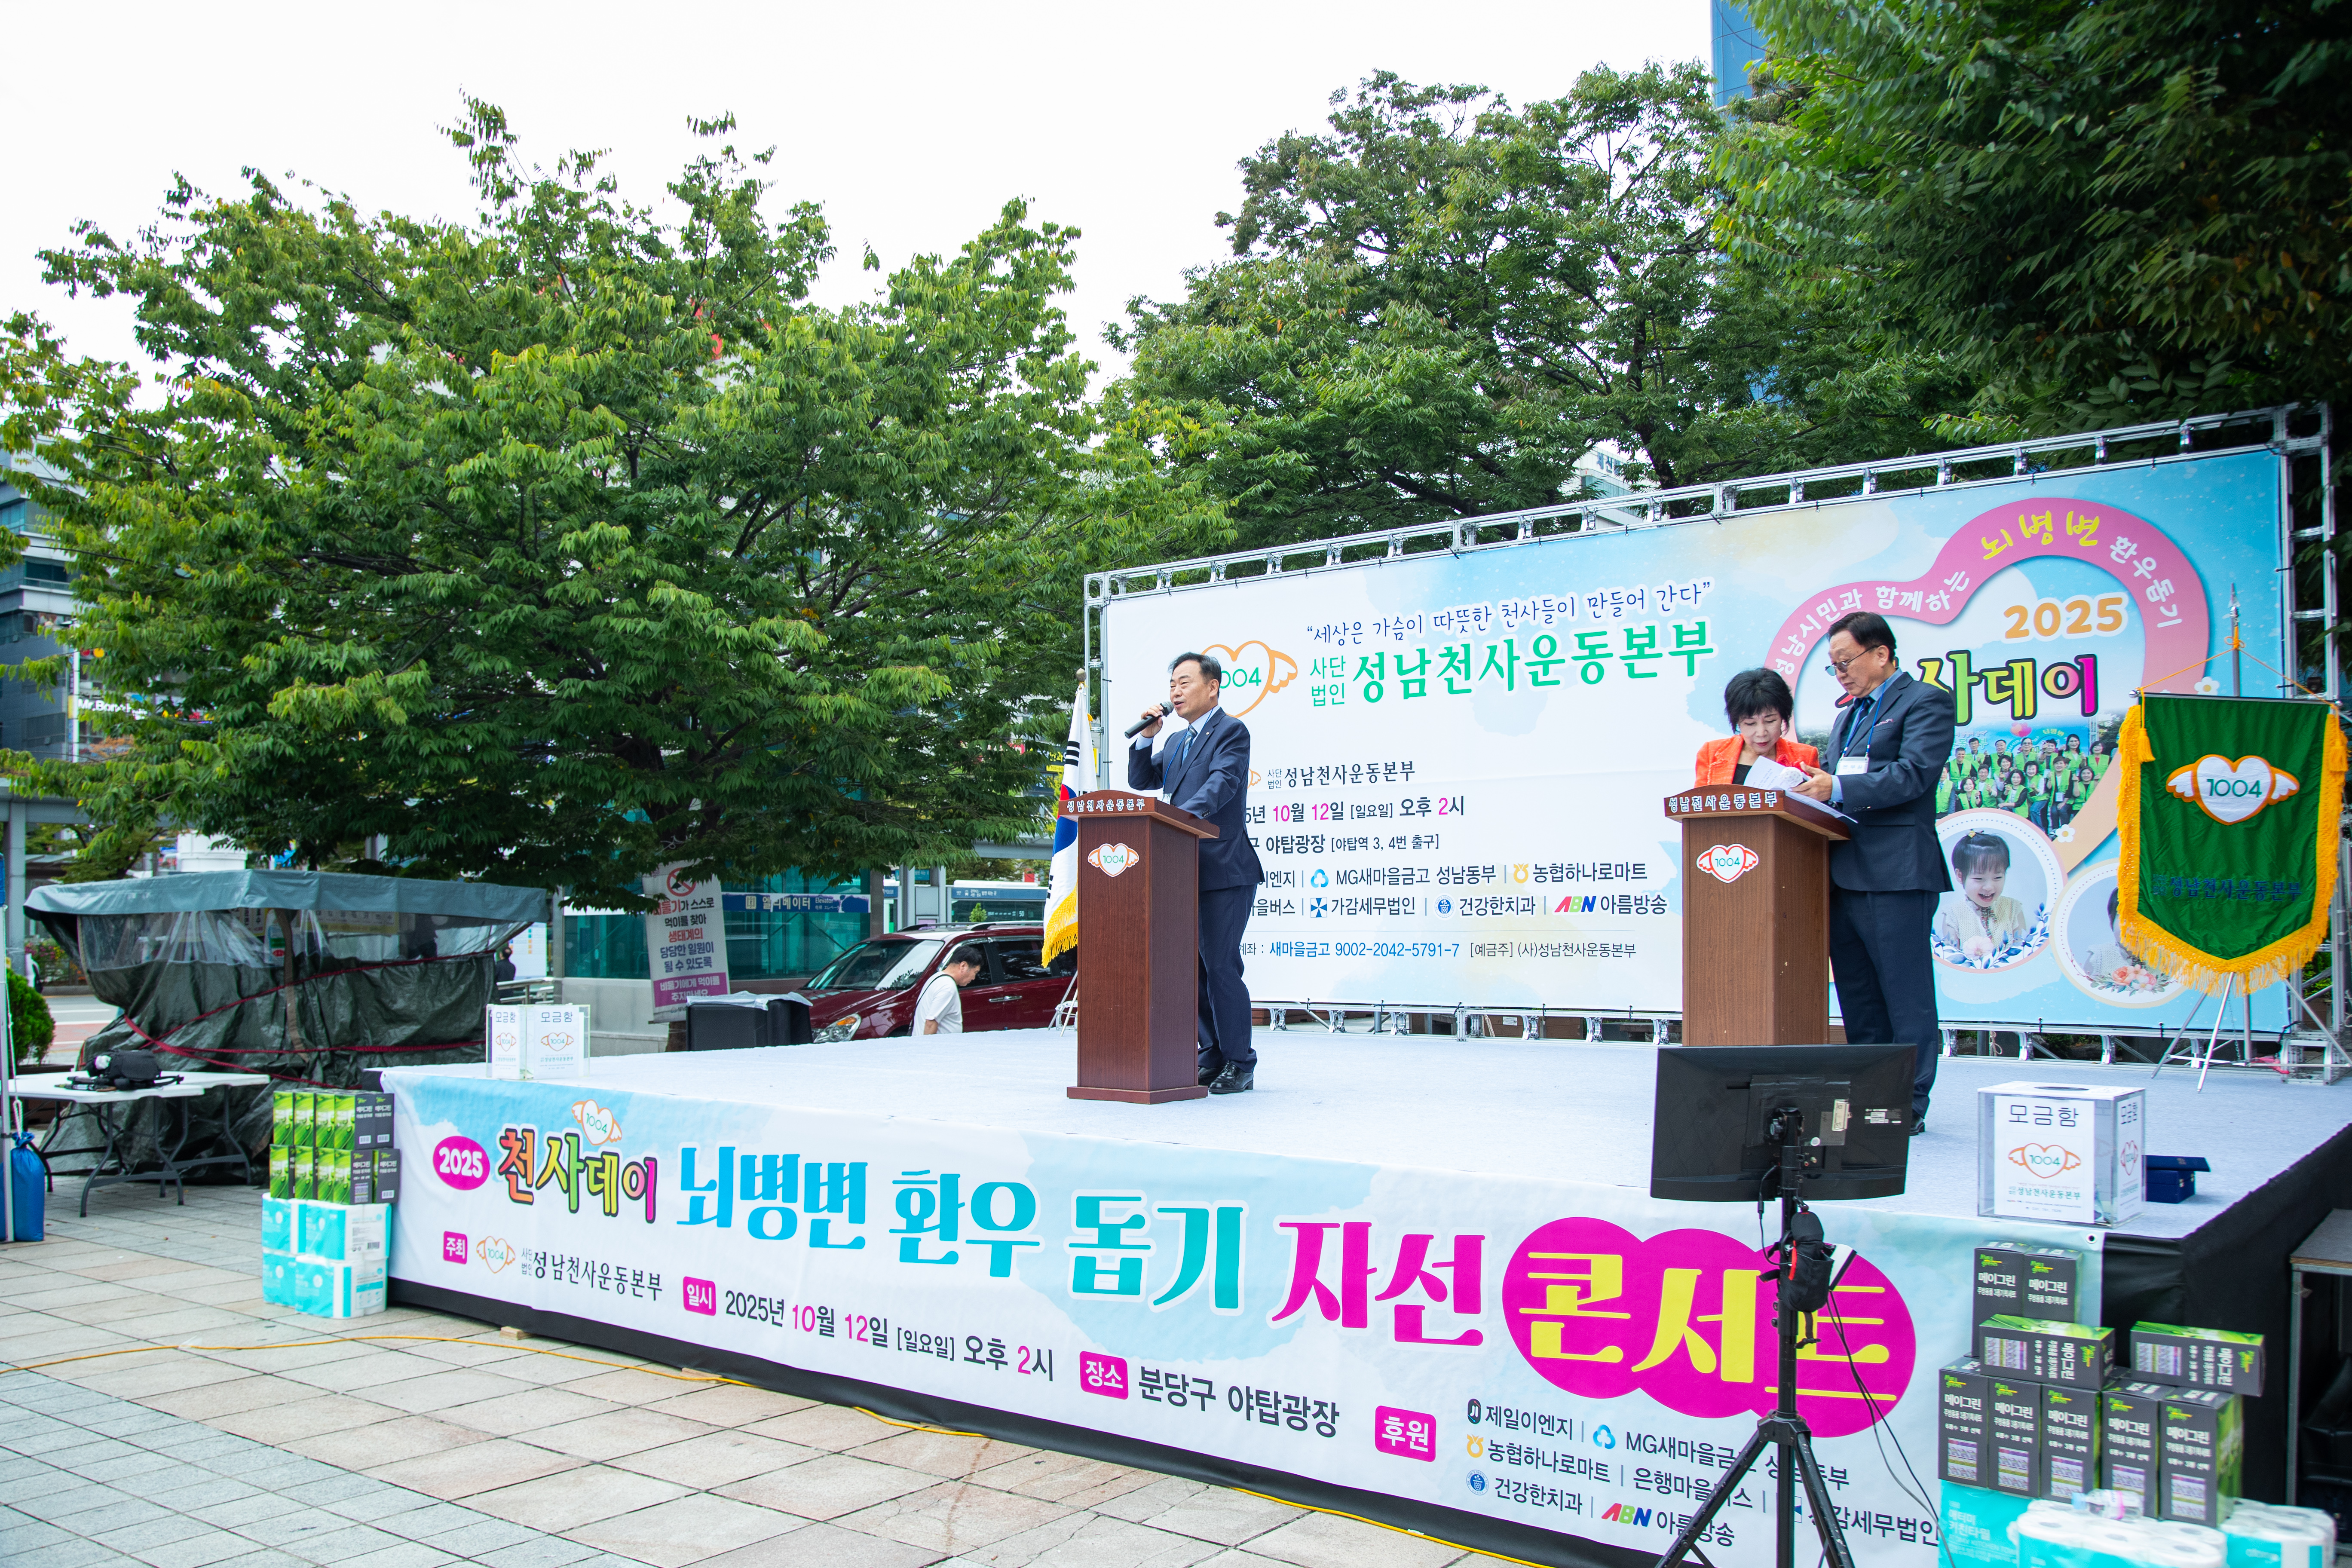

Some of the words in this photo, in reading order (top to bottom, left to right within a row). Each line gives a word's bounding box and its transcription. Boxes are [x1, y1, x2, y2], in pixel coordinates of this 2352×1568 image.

[1773, 588, 1863, 675] 성남시민과
[1875, 570, 1970, 613] 함께하는
[1981, 510, 2100, 560] 뇌병변
[1372, 614, 1423, 641] 가슴이
[1433, 605, 1492, 634] 따뜻한
[1501, 597, 1575, 628] 천사들이
[1587, 588, 1645, 619] 만들어
[2003, 597, 2123, 640] 2025
[1309, 655, 1346, 680] 사단
[1353, 621, 1714, 703] 성남천사운동본부
[1220, 667, 1262, 689] 004
[1834, 649, 2098, 726] 사데이
[1311, 683, 1345, 707] 법인
[1267, 768, 1282, 779] 사단
[1268, 779, 1282, 789] 법인
[1284, 760, 1415, 788] 성남천사운동본부
[2206, 778, 2263, 798] 1004
[1067, 798, 1145, 813] 성남천사운동본부
[1273, 802, 1305, 823] 10월
[1311, 801, 1344, 821] 12일
[1351, 803, 1393, 820] [일요일]
[1399, 796, 1432, 817] 오후
[1438, 795, 1464, 816] 2시
[1668, 791, 1777, 813] 성남천사운동본부
[1265, 834, 1326, 854] 야탑광장
[1331, 836, 1369, 853] [야탑역
[1373, 836, 1384, 851] 3,
[1388, 835, 1407, 850] 4번
[1411, 833, 1440, 850] 출구]
[1102, 855, 1124, 864] 1004
[1715, 857, 1740, 867] 1004
[1336, 867, 1430, 886] MG새마을금고
[1436, 864, 1497, 885] 성남동부
[1533, 861, 1648, 884] 농협하나로마트
[2170, 876, 2302, 902] 성남천사운동본부
[691, 897, 714, 910] 스스로
[1331, 896, 1415, 916] 가감세무법인
[1459, 895, 1536, 916] 건강한치과
[1554, 895, 1597, 913] ABN
[1600, 894, 1667, 915] 아름방송
[665, 916, 689, 928] 먹이를
[690, 914, 707, 926] 찾아
[668, 928, 703, 943] 생태계의
[660, 943, 686, 959] 당당한
[688, 941, 714, 955] 일원이
[1270, 941, 1330, 958] 새마을금고
[1335, 942, 1460, 957] 9002-2042-5791-7
[1470, 942, 1513, 958] [예금주]
[1517, 942, 1636, 959] (사)성남천사운동본부
[664, 961, 673, 973] 될
[675, 960, 684, 971] 수
[686, 956, 712, 970] 있도록
[660, 977, 697, 992] 비둘기에게
[698, 975, 720, 987] 먹이를
[496, 1011, 516, 1023] 모금함
[540, 1011, 573, 1023] 모금함
[586, 1112, 607, 1134] 1004
[2008, 1104, 2080, 1127] 모금함
[2029, 1154, 2061, 1166] 1004
[2017, 1187, 2081, 1200] 성남천사운동본부
[439, 1147, 483, 1178] 2025
[498, 1128, 658, 1224] 천사데이
[676, 1146, 868, 1250] 뇌병변
[889, 1169, 1040, 1278] 환우
[1069, 1196, 1243, 1309] 돕기
[1271, 1222, 1485, 1346] 자선
[446, 1237, 466, 1259] 주최
[487, 1248, 504, 1261] 1004
[533, 1251, 662, 1301] 성남천사운동본부
[1978, 1272, 2016, 1286] 메이그린
[2028, 1278, 2068, 1294] 메이그린
[686, 1283, 712, 1310] 일시
[726, 1290, 785, 1327] 2025년
[792, 1304, 835, 1338] 10월
[845, 1313, 888, 1348] 12일
[897, 1327, 955, 1362] [일요일]
[964, 1335, 1008, 1371] 오후
[1017, 1345, 1054, 1381] 2시
[2061, 1342, 2076, 1380] 메이그린
[2217, 1347, 2234, 1386] 메이그린
[1085, 1361, 1123, 1389] 장소
[1139, 1366, 1216, 1412] 분당구
[1227, 1385, 1340, 1438] 야탑광장
[1944, 1393, 1982, 1410] 메이그린
[1994, 1402, 2034, 1419] 메이그린
[2047, 1410, 2088, 1427] 메이그린
[2108, 1418, 2150, 1436] 메이그린
[1381, 1416, 1429, 1452] 후원
[2166, 1426, 2210, 1445] 메이그린
[1485, 1405, 1573, 1440] 제일이엔지
[1626, 1431, 1757, 1473] MG새마을금
[1765, 1455, 1850, 1491] 성부
[1488, 1439, 1611, 1483] 농협하나로마트
[1633, 1467, 1753, 1509] 은행마을스
[1494, 1477, 1583, 1516] 건강한치과
[1601, 1502, 1652, 1527] ABN
[1808, 1505, 1939, 1547] 감세무법인
